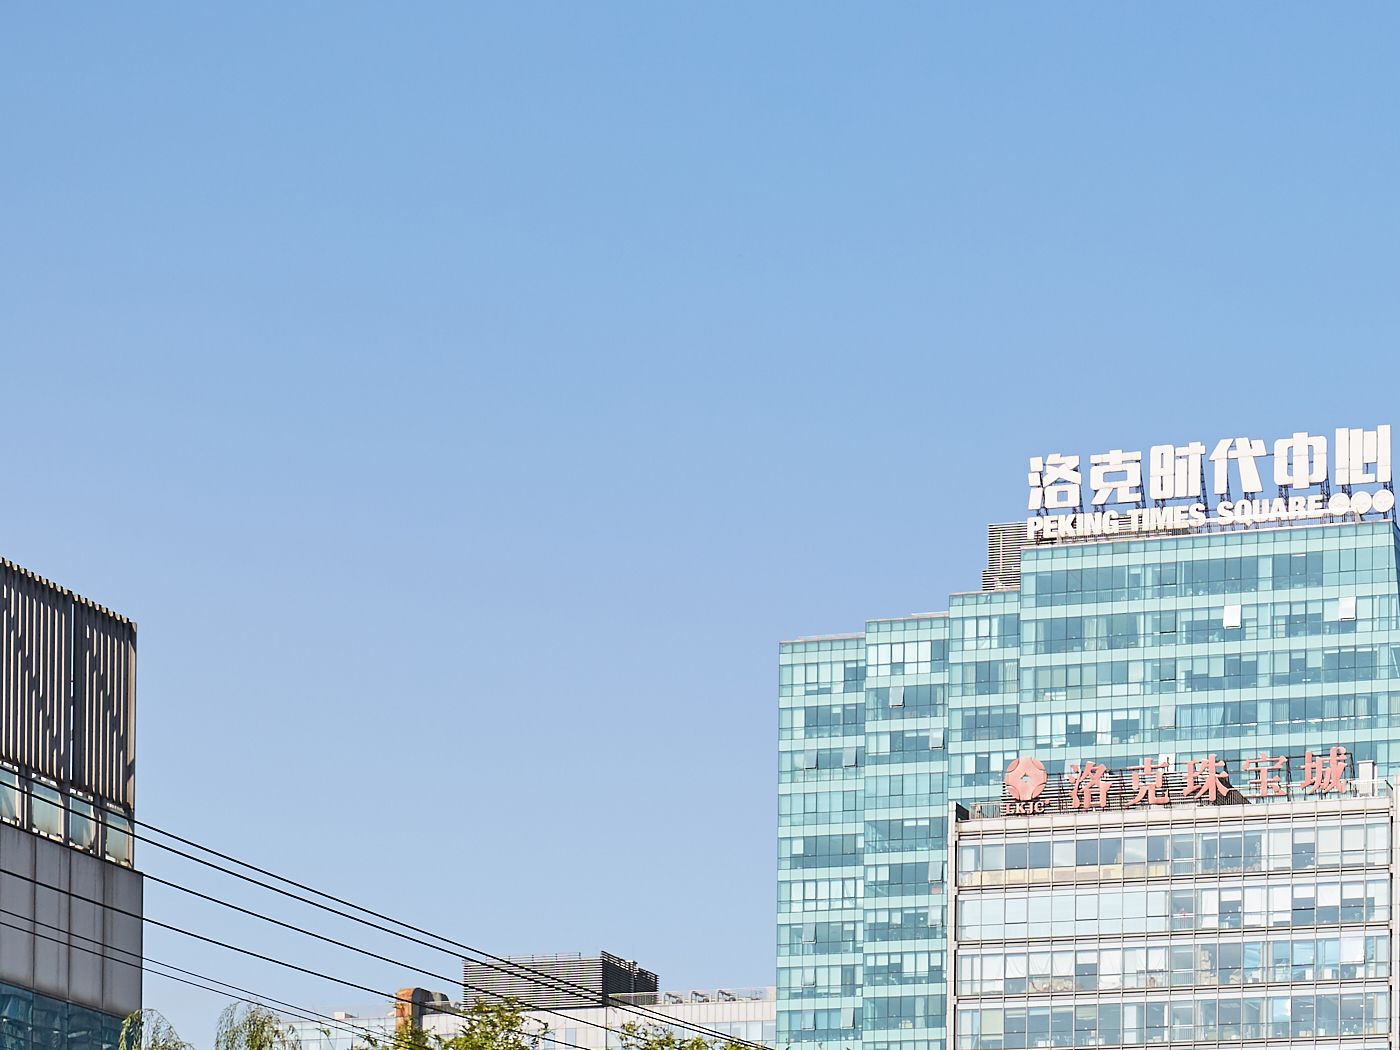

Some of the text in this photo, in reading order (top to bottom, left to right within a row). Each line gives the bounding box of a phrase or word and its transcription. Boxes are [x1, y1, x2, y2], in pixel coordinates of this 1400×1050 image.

[1027, 424, 1391, 510] 洛克时代中心
[1027, 494, 1325, 540] PEKING TIMES SQUARE
[1068, 747, 1347, 809] 洛克珠宝城
